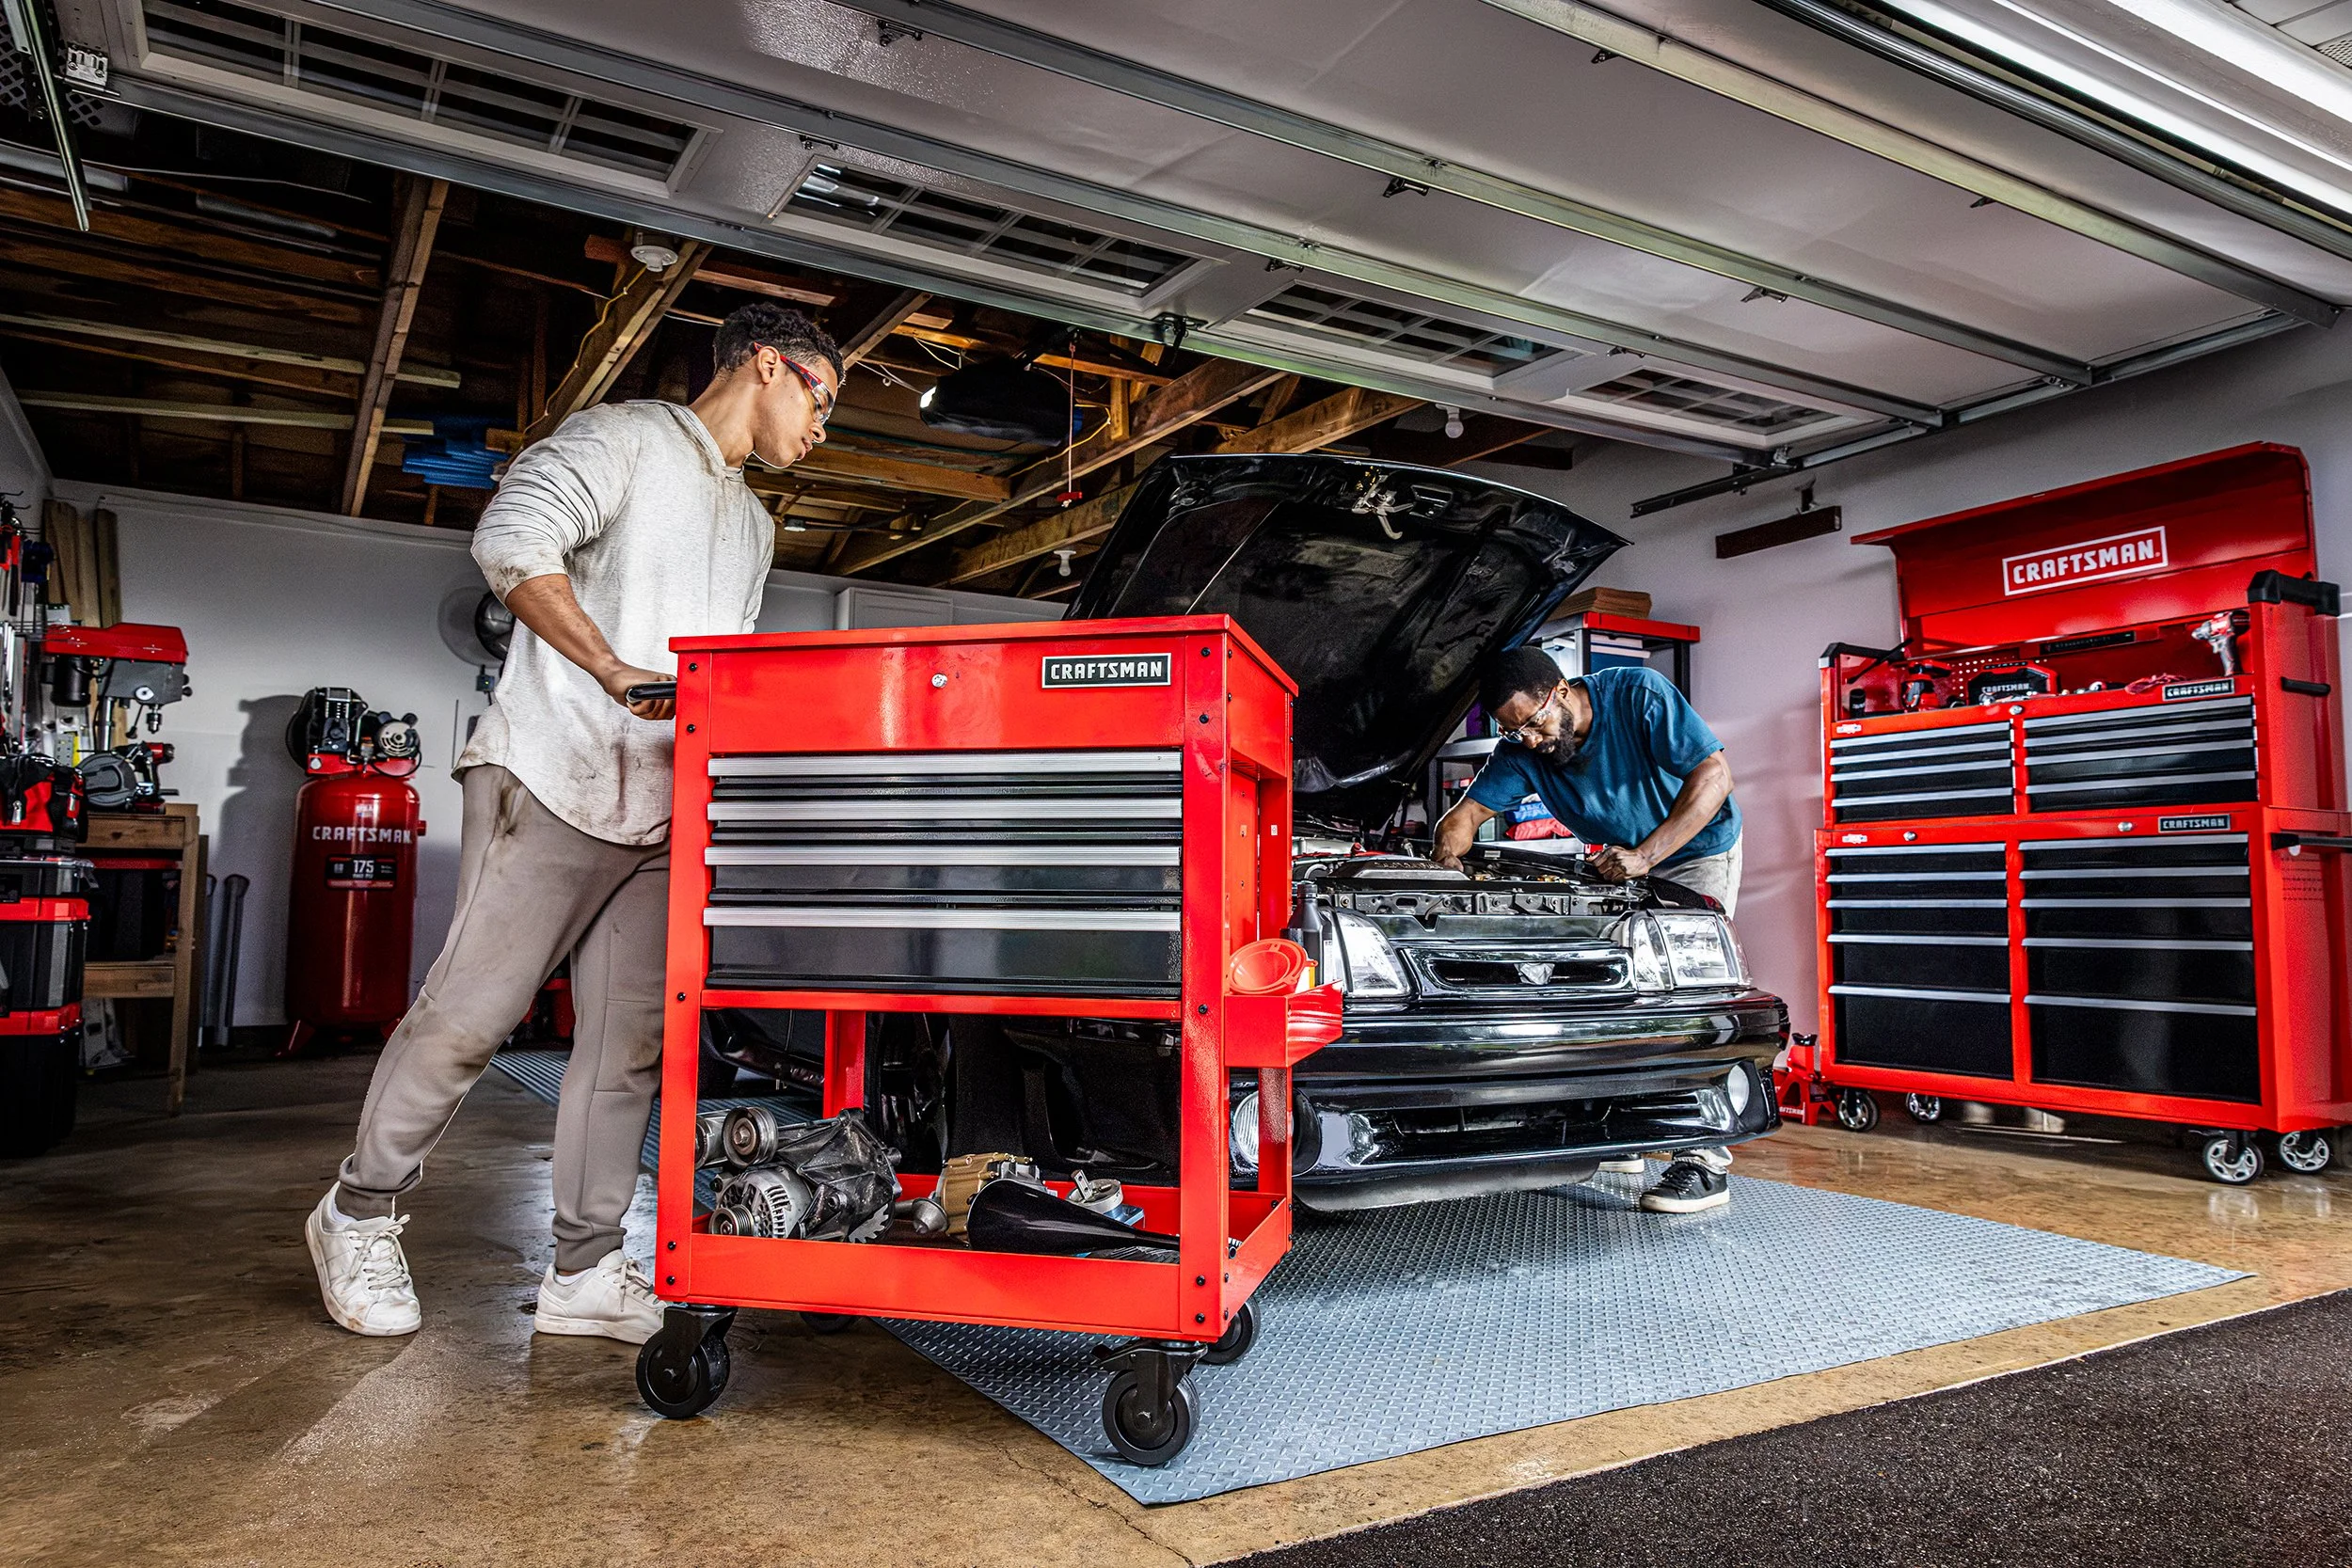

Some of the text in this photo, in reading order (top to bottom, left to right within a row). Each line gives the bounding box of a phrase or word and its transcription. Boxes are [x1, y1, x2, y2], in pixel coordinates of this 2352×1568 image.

[2012, 539, 2155, 584] CRAFTSMAN
[1050, 661, 1163, 680] CRAFTSMAN
[2167, 682, 2230, 697] CRAFTSMAN
[2162, 817, 2226, 830] CRAFTSMAN
[312, 826, 412, 844] CRAFTSMAN
[353, 860, 374, 873] 175
